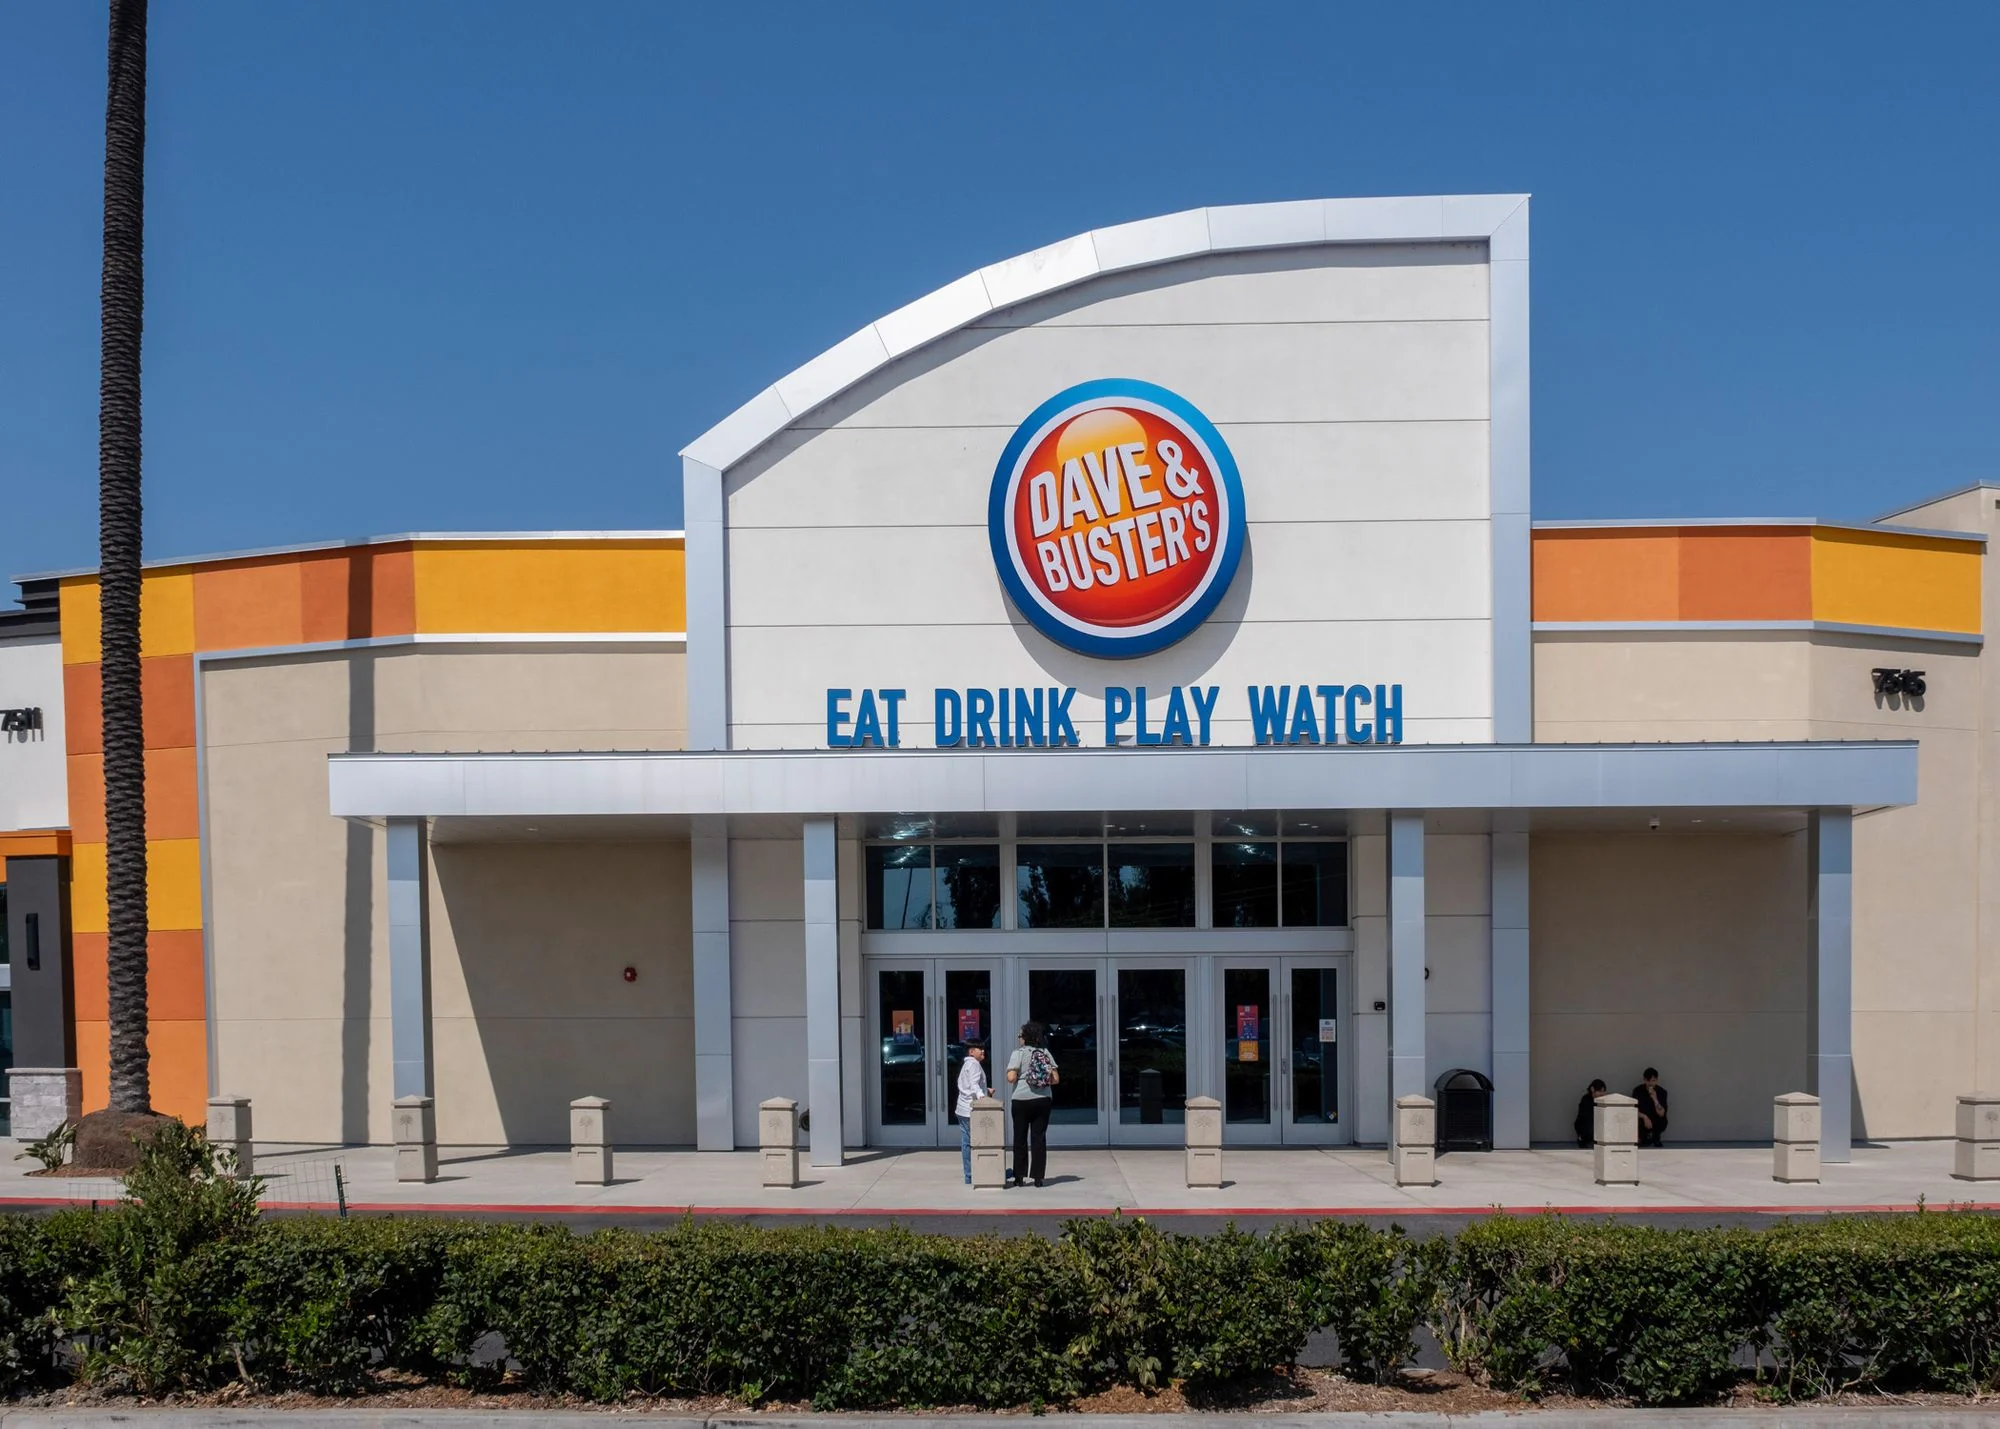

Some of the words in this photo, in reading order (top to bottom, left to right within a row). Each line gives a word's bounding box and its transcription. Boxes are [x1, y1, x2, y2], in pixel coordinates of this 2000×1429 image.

[1029, 441, 1163, 539] DAVE
[1156, 439, 1205, 499] &
[1036, 499, 1211, 593] BUSTER'S
[827, 688, 906, 747] EAT
[934, 687, 1080, 747] DRINK
[1105, 686, 1220, 746] PLAY
[1247, 684, 1404, 745] WATCH
